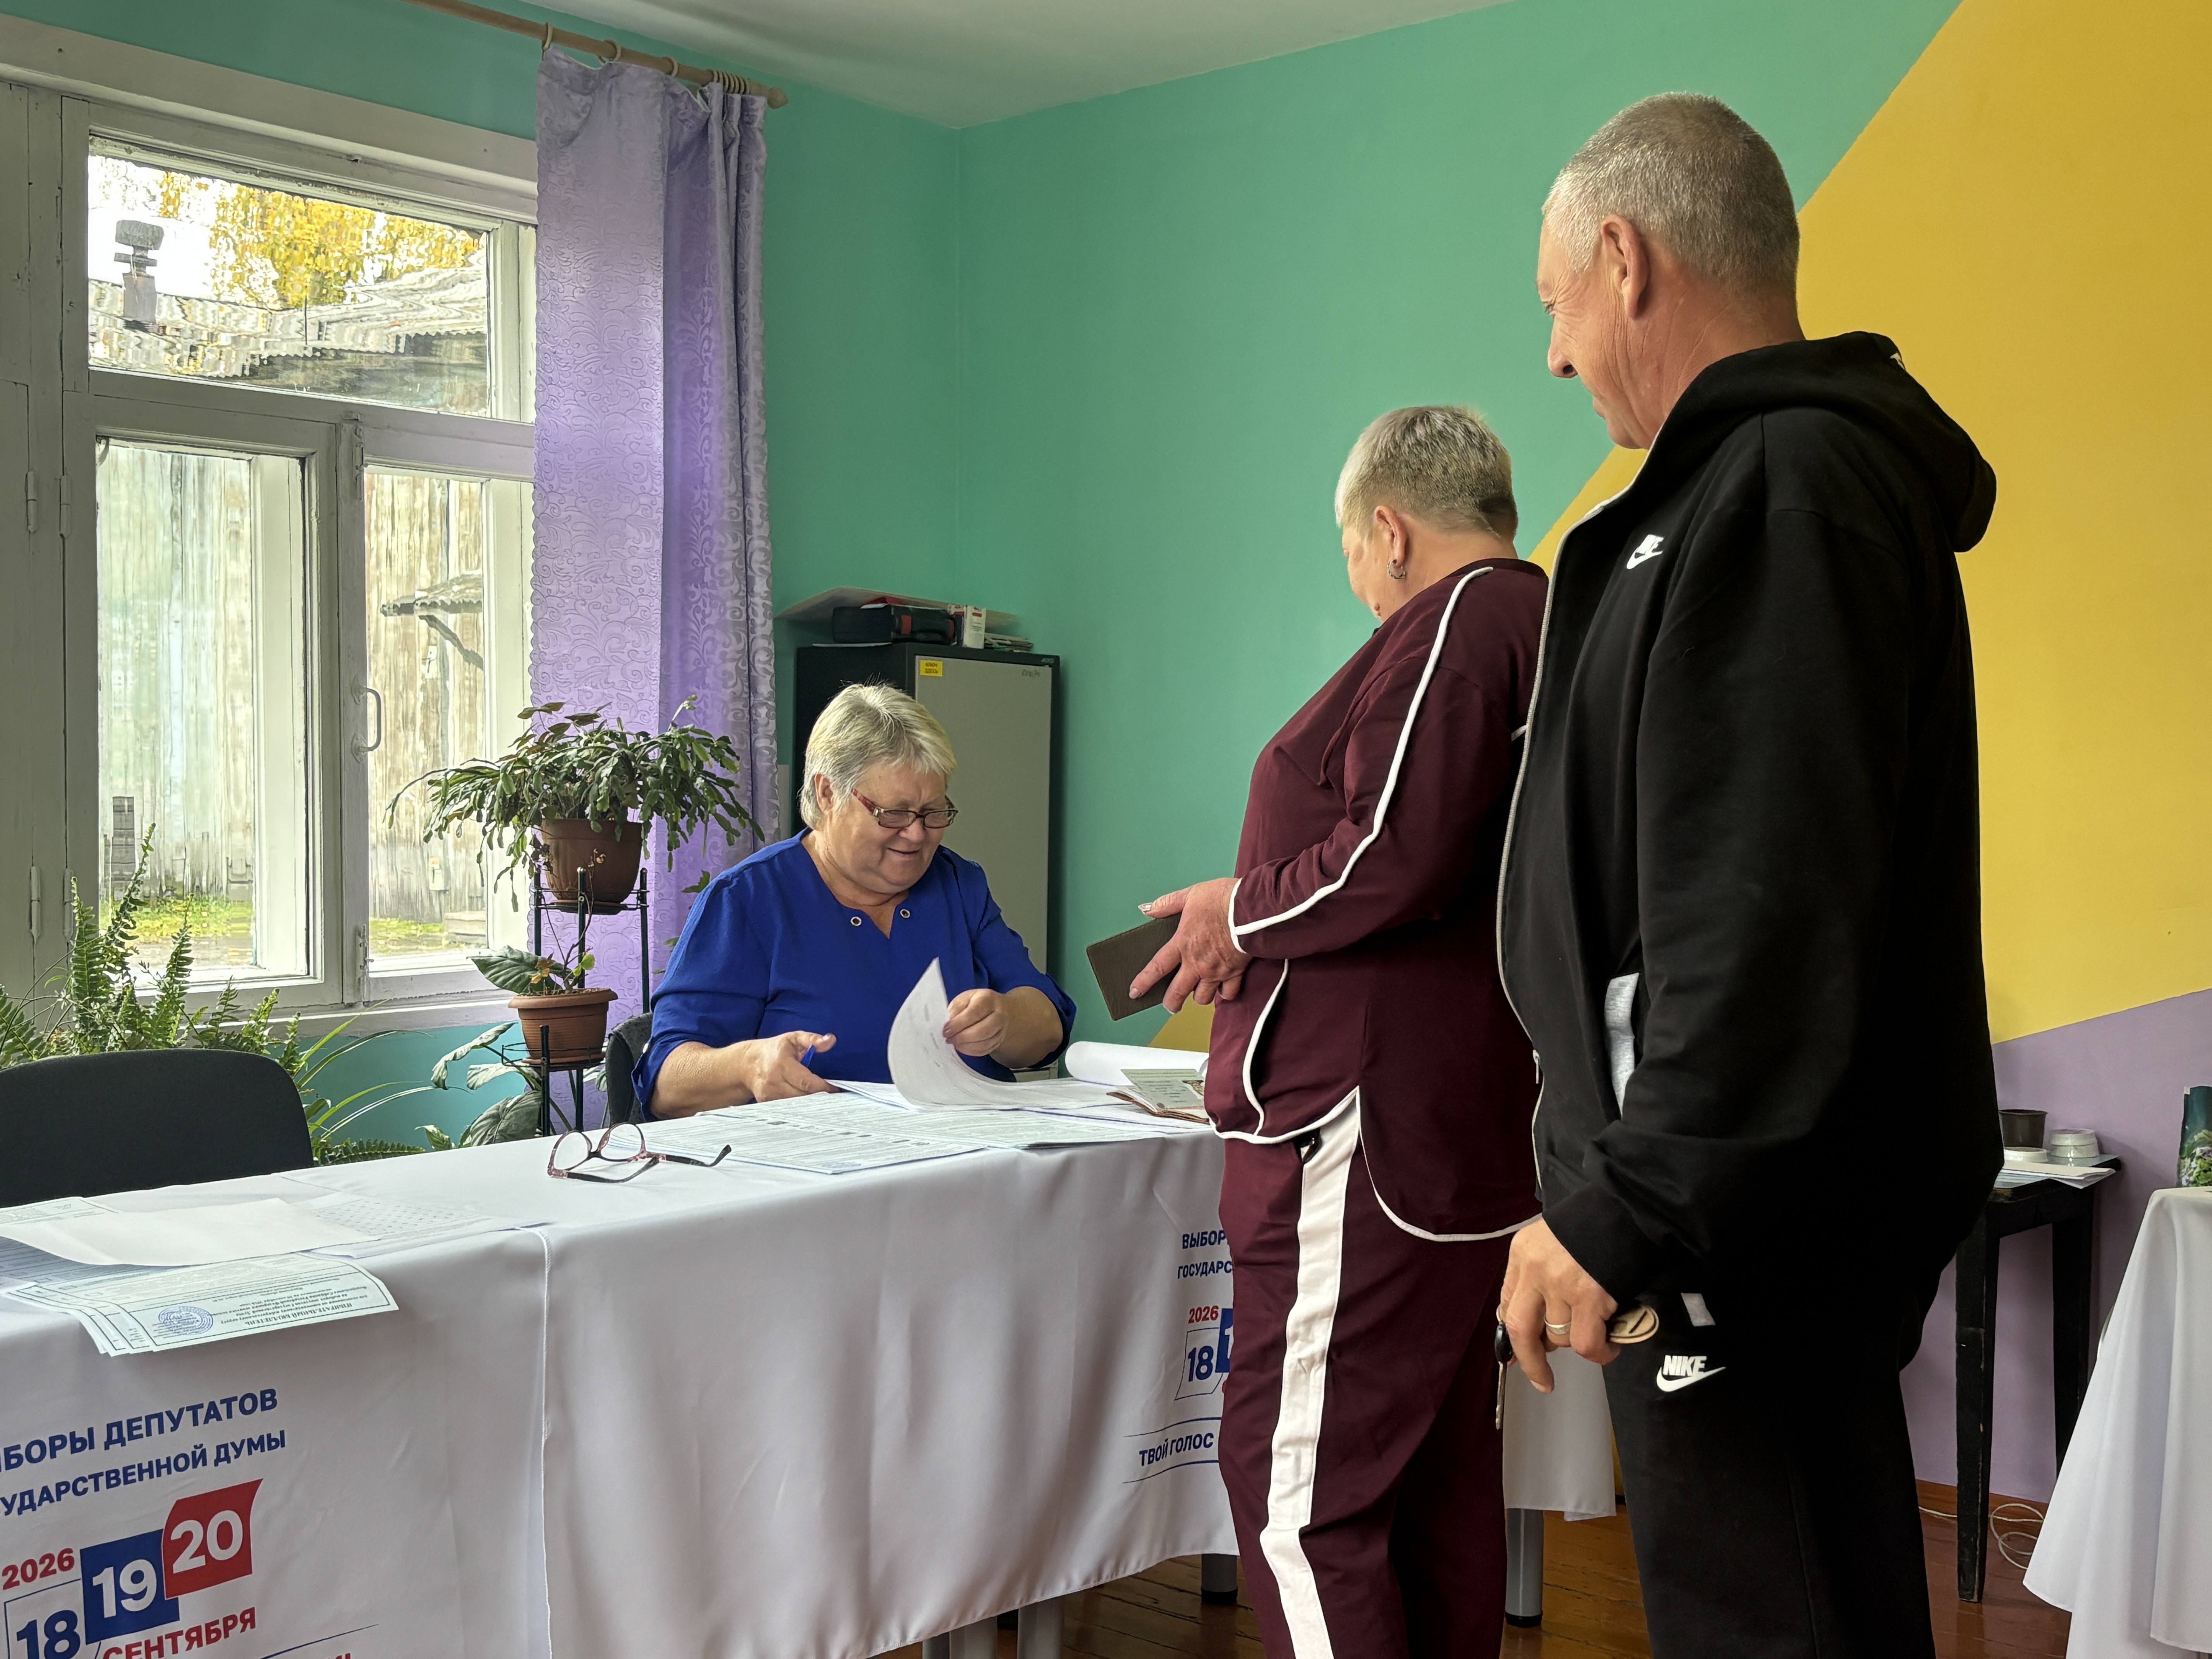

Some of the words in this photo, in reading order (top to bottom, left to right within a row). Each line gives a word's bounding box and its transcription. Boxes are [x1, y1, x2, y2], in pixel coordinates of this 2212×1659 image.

[1182, 1230, 1226, 1249] ВЫБОР
[1178, 1261, 1233, 1279] ГОСУДАРС
[1188, 1305, 1219, 1324] 2026
[1224, 1325, 1234, 1359] 1
[1188, 1346, 1214, 1382] 18
[1663, 1355, 1707, 1377] NIKE
[0, 1427, 94, 1471] БОРЫ
[104, 1389, 277, 1450] ДЕПУТАТОВ
[1139, 1438, 1168, 1466] ТВОЙ
[1170, 1433, 1214, 1455] ГОЛОС
[0, 1443, 207, 1516] УДАРСТВЕННОЙ
[214, 1430, 285, 1466] ДУМЫ
[171, 1510, 243, 1573] 20
[2, 1548, 74, 1590] 2026
[93, 1559, 157, 1618] 19
[17, 1610, 80, 1659] 18
[103, 1607, 256, 1659] СЕНТЯБРЯ
